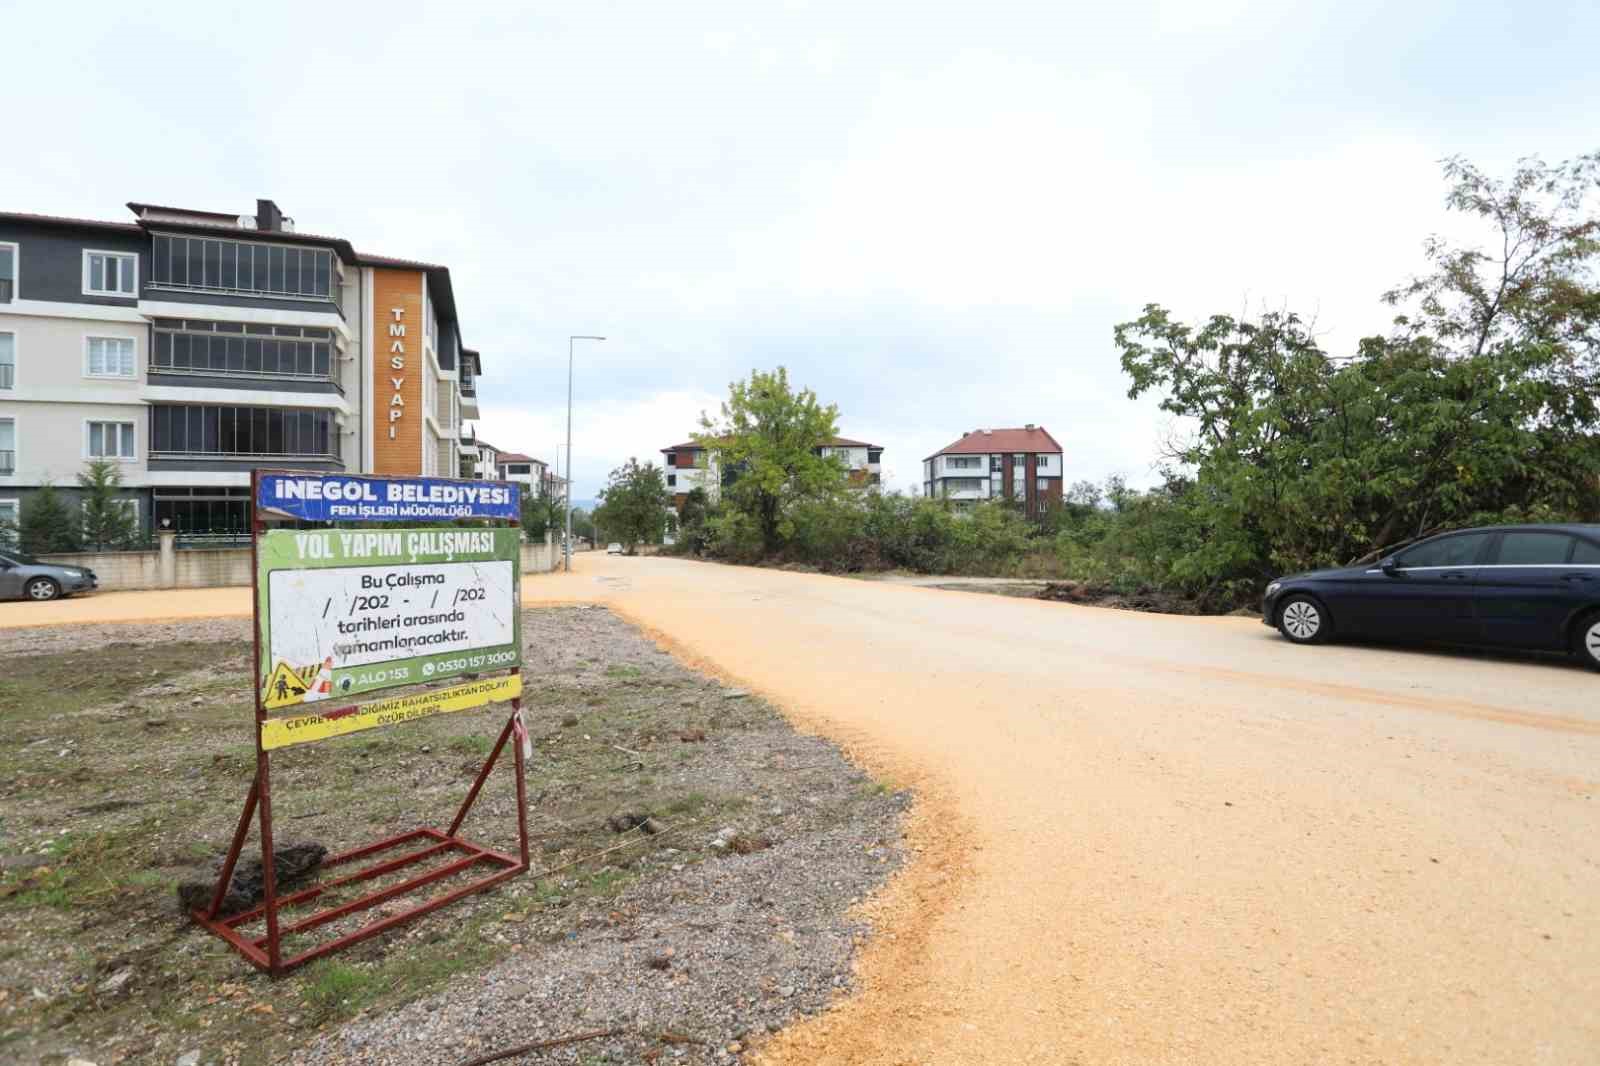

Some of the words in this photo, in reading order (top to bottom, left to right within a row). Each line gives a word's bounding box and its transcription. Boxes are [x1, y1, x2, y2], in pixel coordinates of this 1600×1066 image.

[389, 377, 404, 439] YAPI
[275, 479, 378, 501] İNEGÖL
[386, 483, 510, 505] BELEDİYESİ
[330, 504, 357, 516] FEN
[359, 502, 398, 519] İŞLERİ
[400, 503, 473, 517] MÜDÜRLÜĞÜ
[295, 533, 335, 559] YOL
[340, 532, 402, 558] YAPIM
[407, 531, 495, 563] ÇALIŞMASI
[361, 574, 384, 589] Bu
[385, 571, 446, 591] Çalışma
[337, 613, 401, 635] tarihleri
[403, 608, 465, 627] arasında
[357, 669, 387, 686] ALO
[388, 666, 410, 681] 153
[436, 658, 468, 673] 0530
[469, 655, 486, 668] 157
[486, 650, 517, 664] 3000
